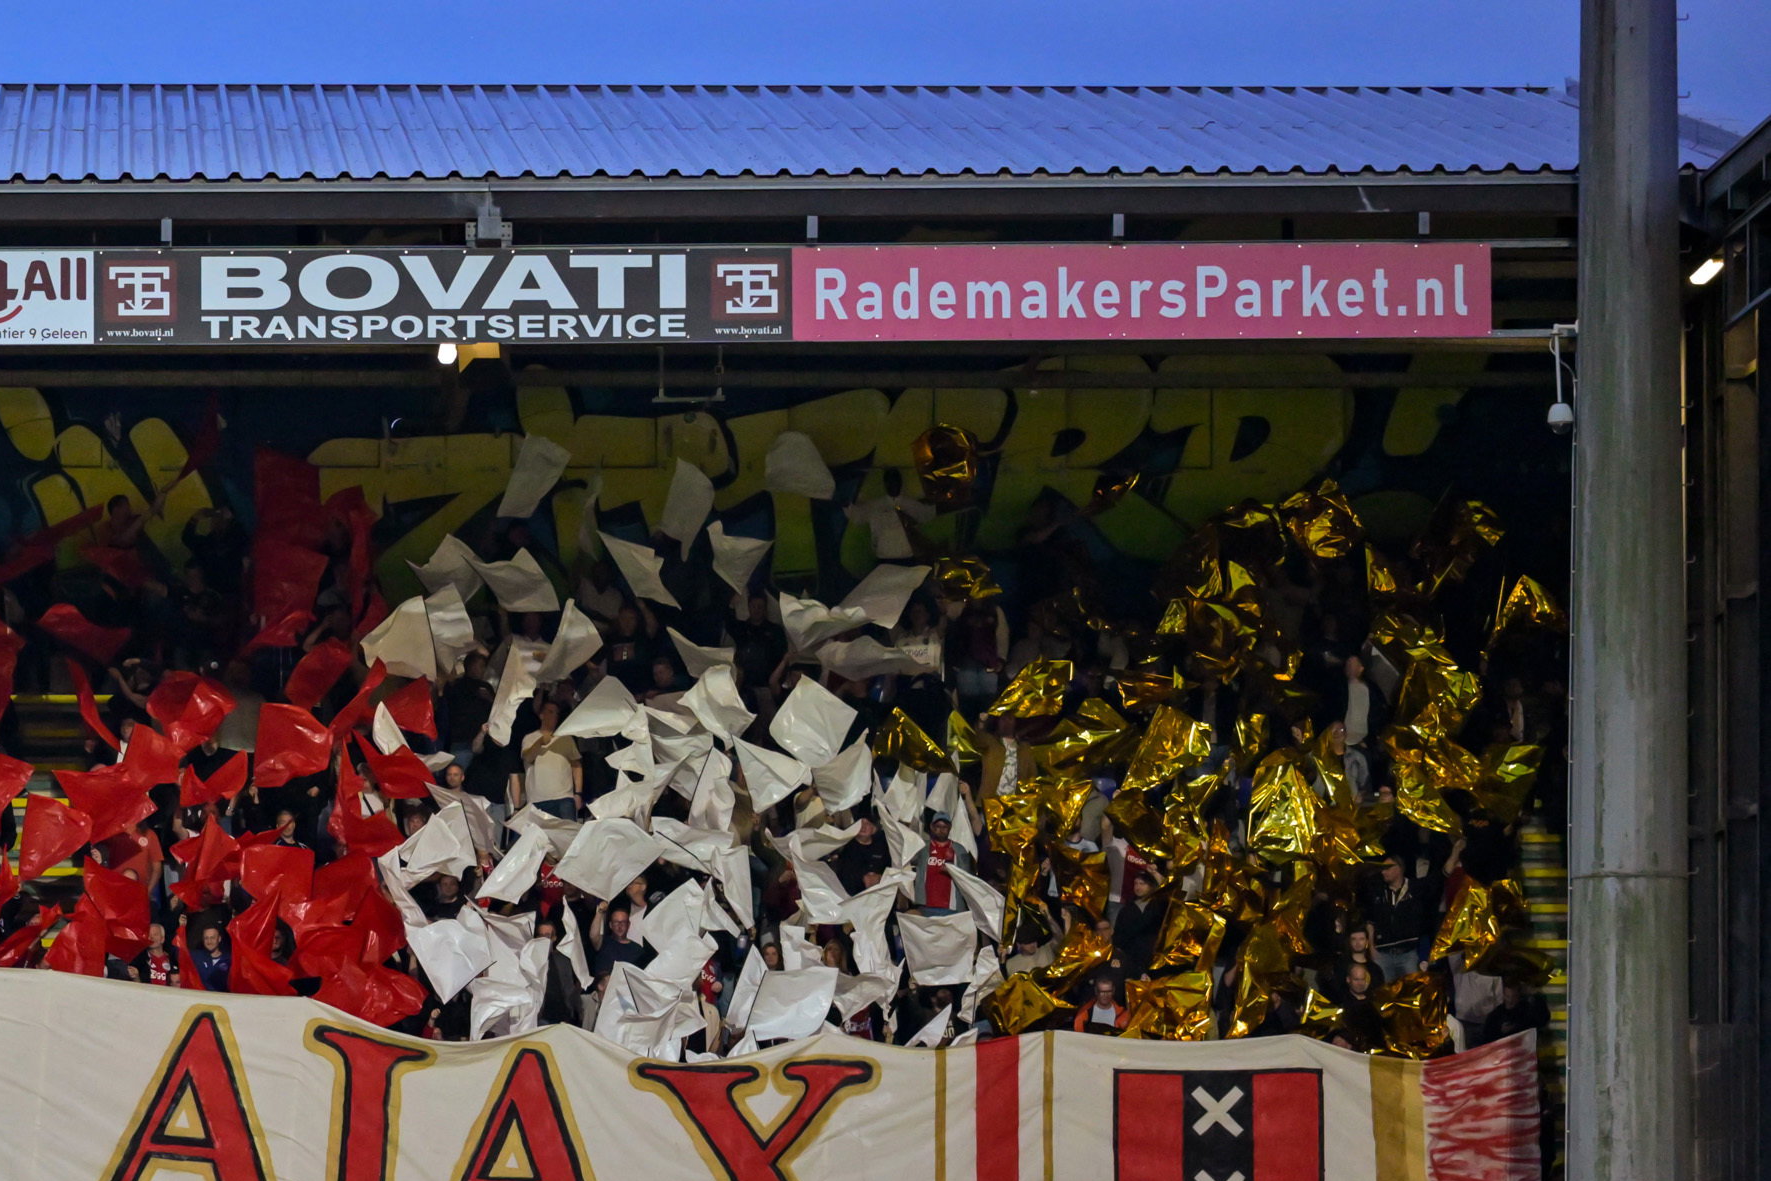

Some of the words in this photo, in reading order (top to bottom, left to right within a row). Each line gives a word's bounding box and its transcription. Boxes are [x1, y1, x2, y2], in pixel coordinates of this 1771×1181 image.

[201, 254, 686, 310] BOVATI
[815, 265, 1469, 320] RademakersParket.nl
[29, 328, 38, 340] 9
[40, 327, 88, 341] Geleen
[107, 327, 174, 338] www.bovati.nl
[201, 314, 687, 338] TRANSPORTSERVICE
[714, 324, 783, 336] www.bovati.nl
